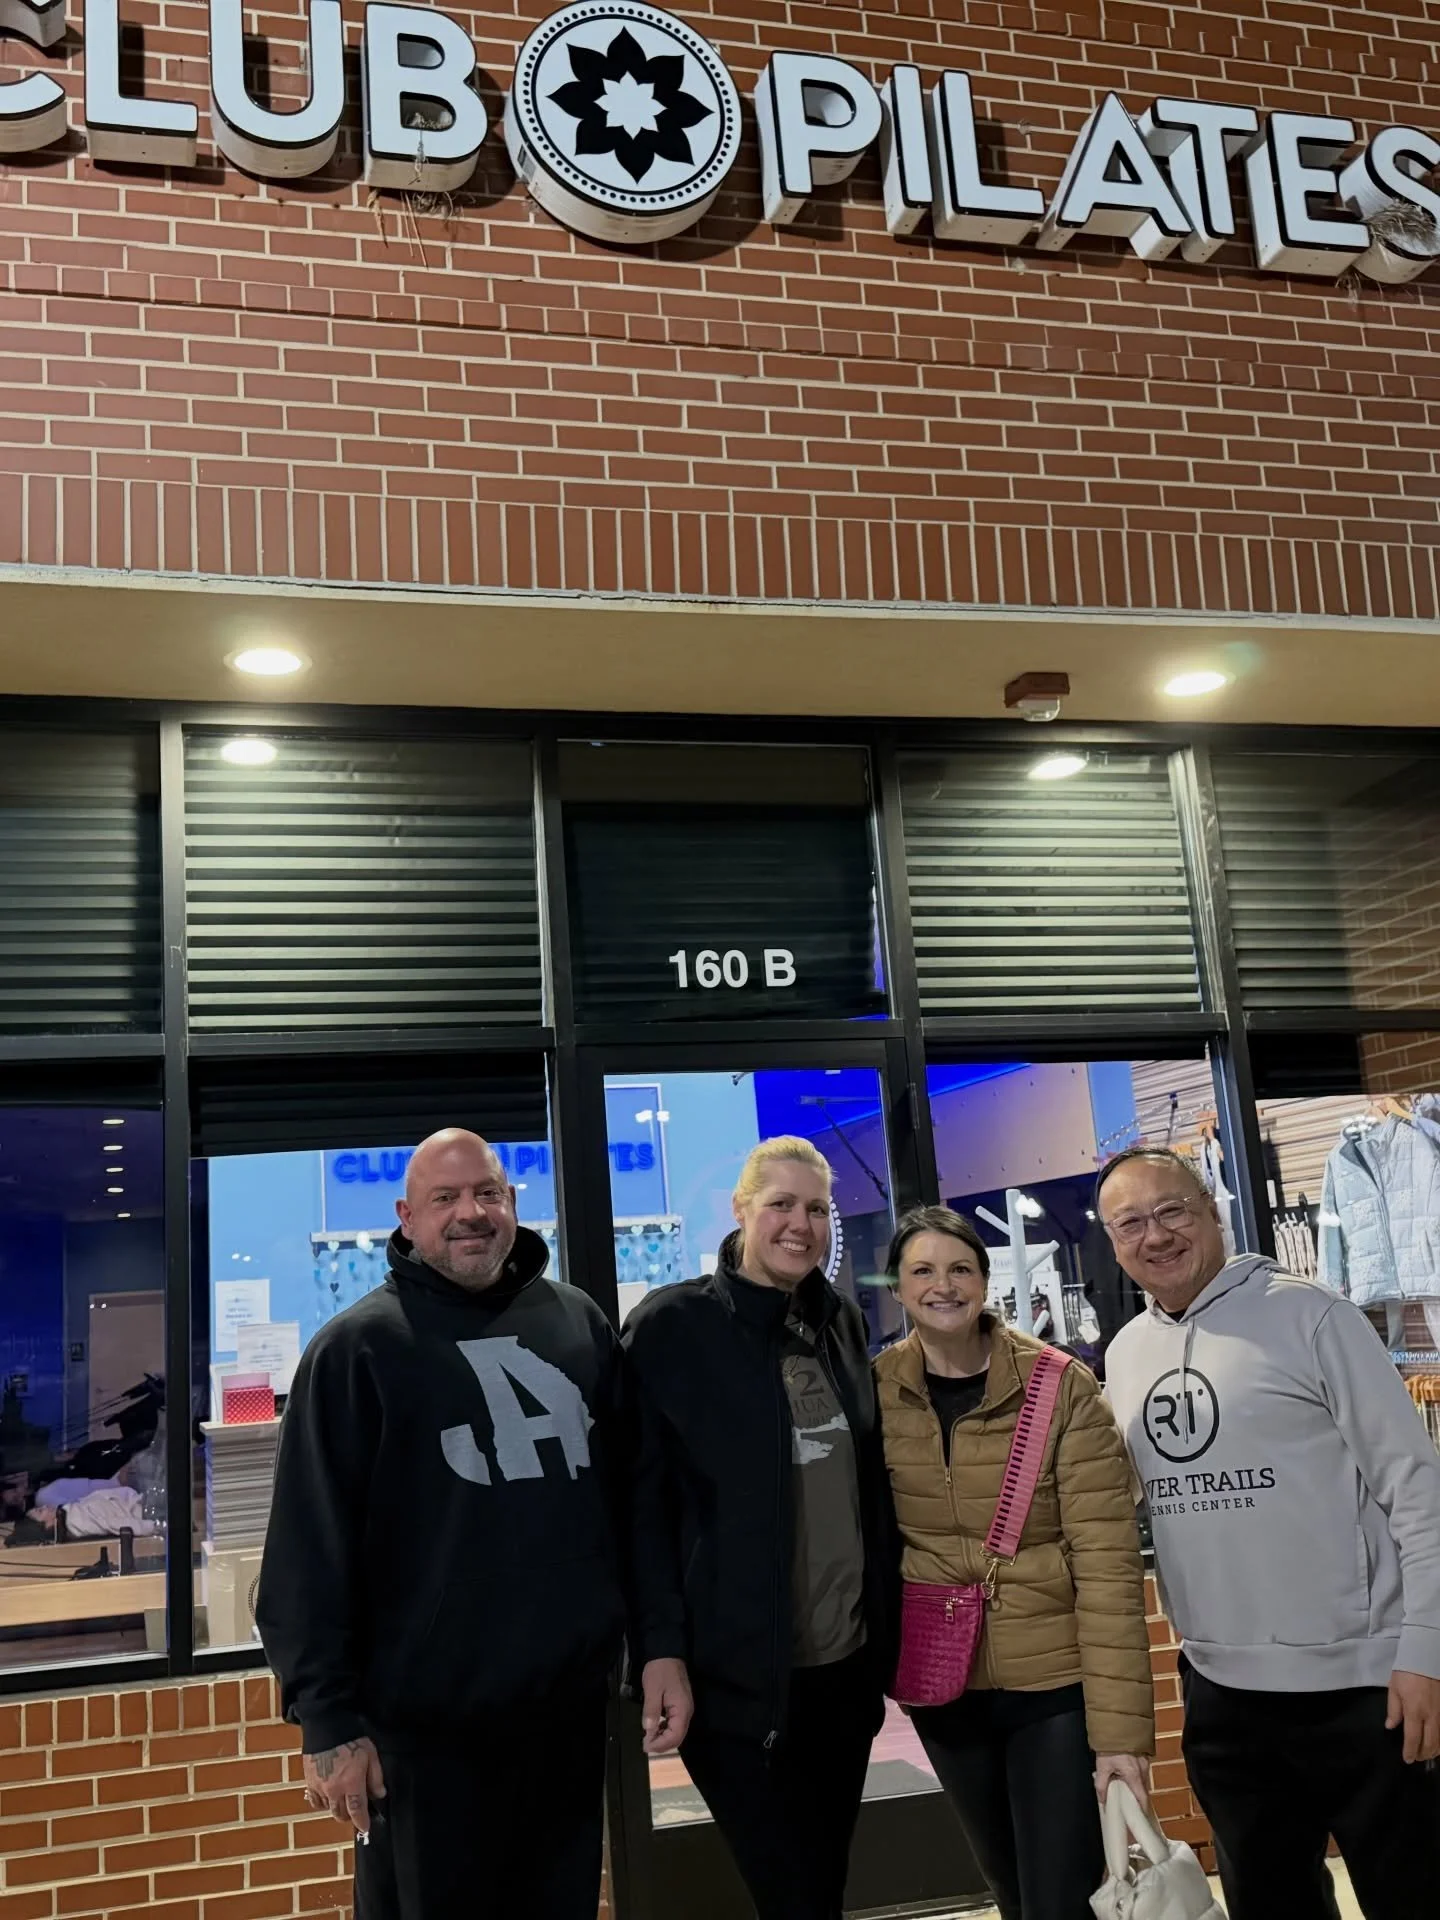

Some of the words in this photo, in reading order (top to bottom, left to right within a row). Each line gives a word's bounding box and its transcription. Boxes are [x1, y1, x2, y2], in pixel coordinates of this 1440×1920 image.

[770, 50, 1440, 262] PILATES
[668, 949, 749, 988] 160
[763, 948, 797, 988] B
[332, 1151, 413, 1184] CLU
[1145, 1476, 1183, 1500] VER
[1185, 1467, 1276, 1495] TRAILS
[1151, 1503, 1186, 1516] ENNIS
[1192, 1497, 1256, 1513] CENTER
